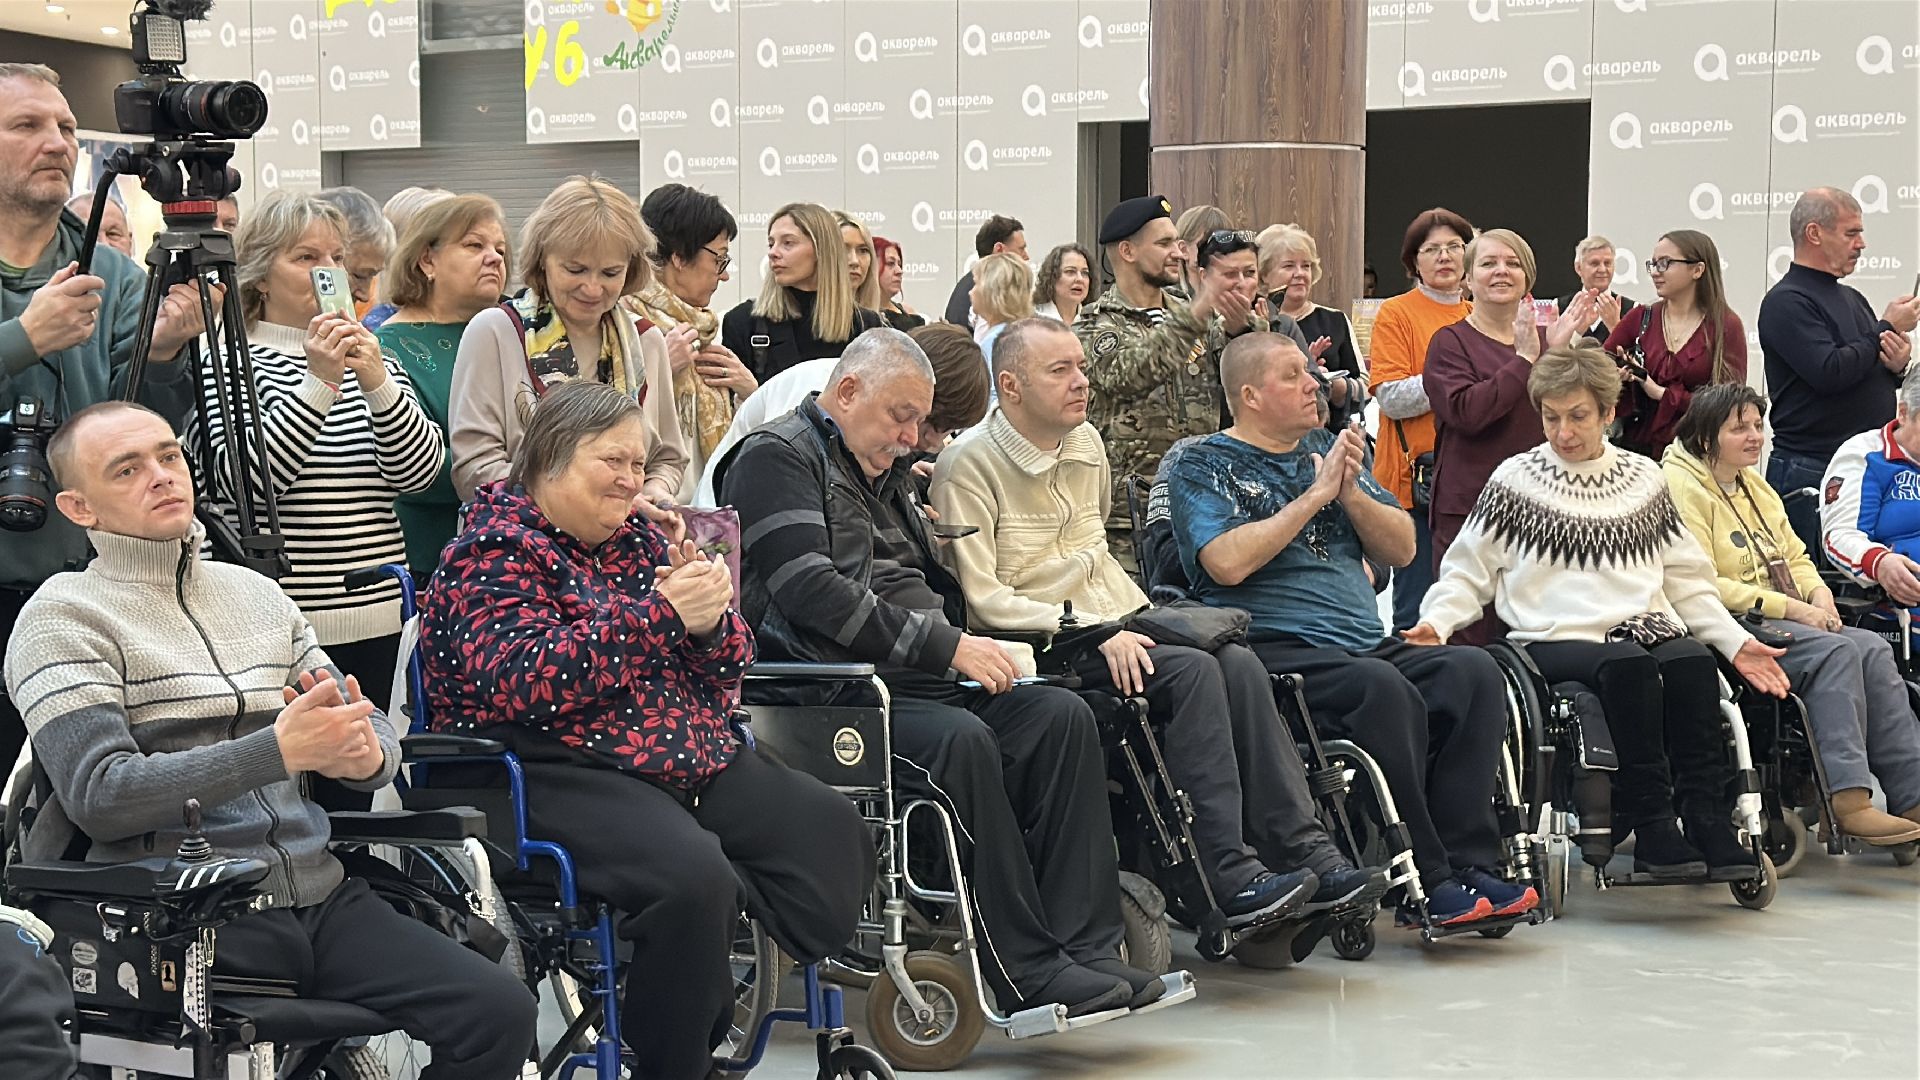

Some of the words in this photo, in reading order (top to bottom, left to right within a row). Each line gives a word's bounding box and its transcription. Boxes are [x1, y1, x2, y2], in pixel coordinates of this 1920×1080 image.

[548, 2, 594, 15] акварель
[991, 30, 1050, 43] акварель
[782, 43, 835, 56] акварель
[882, 37, 938, 50] акварель
[685, 49, 735, 61] акварель
[1736, 50, 1821, 66] акварель
[1583, 59, 1661, 77] акварель
[1432, 68, 1507, 83] акварель
[938, 95, 993, 108] акварель
[1051, 90, 1108, 103] акварель
[735, 105, 784, 116] акварель
[834, 102, 885, 114] акварель
[550, 113, 596, 124] акварель
[640, 111, 687, 122] акварель
[1815, 112, 1906, 129] акварель
[1650, 120, 1733, 135] акварель
[785, 154, 837, 164] акварель
[884, 151, 939, 163] акварель
[993, 146, 1052, 160] акварель
[688, 157, 738, 167] акварель
[901, 262, 939, 275] арель
[1857, 254, 1901, 271] рель
